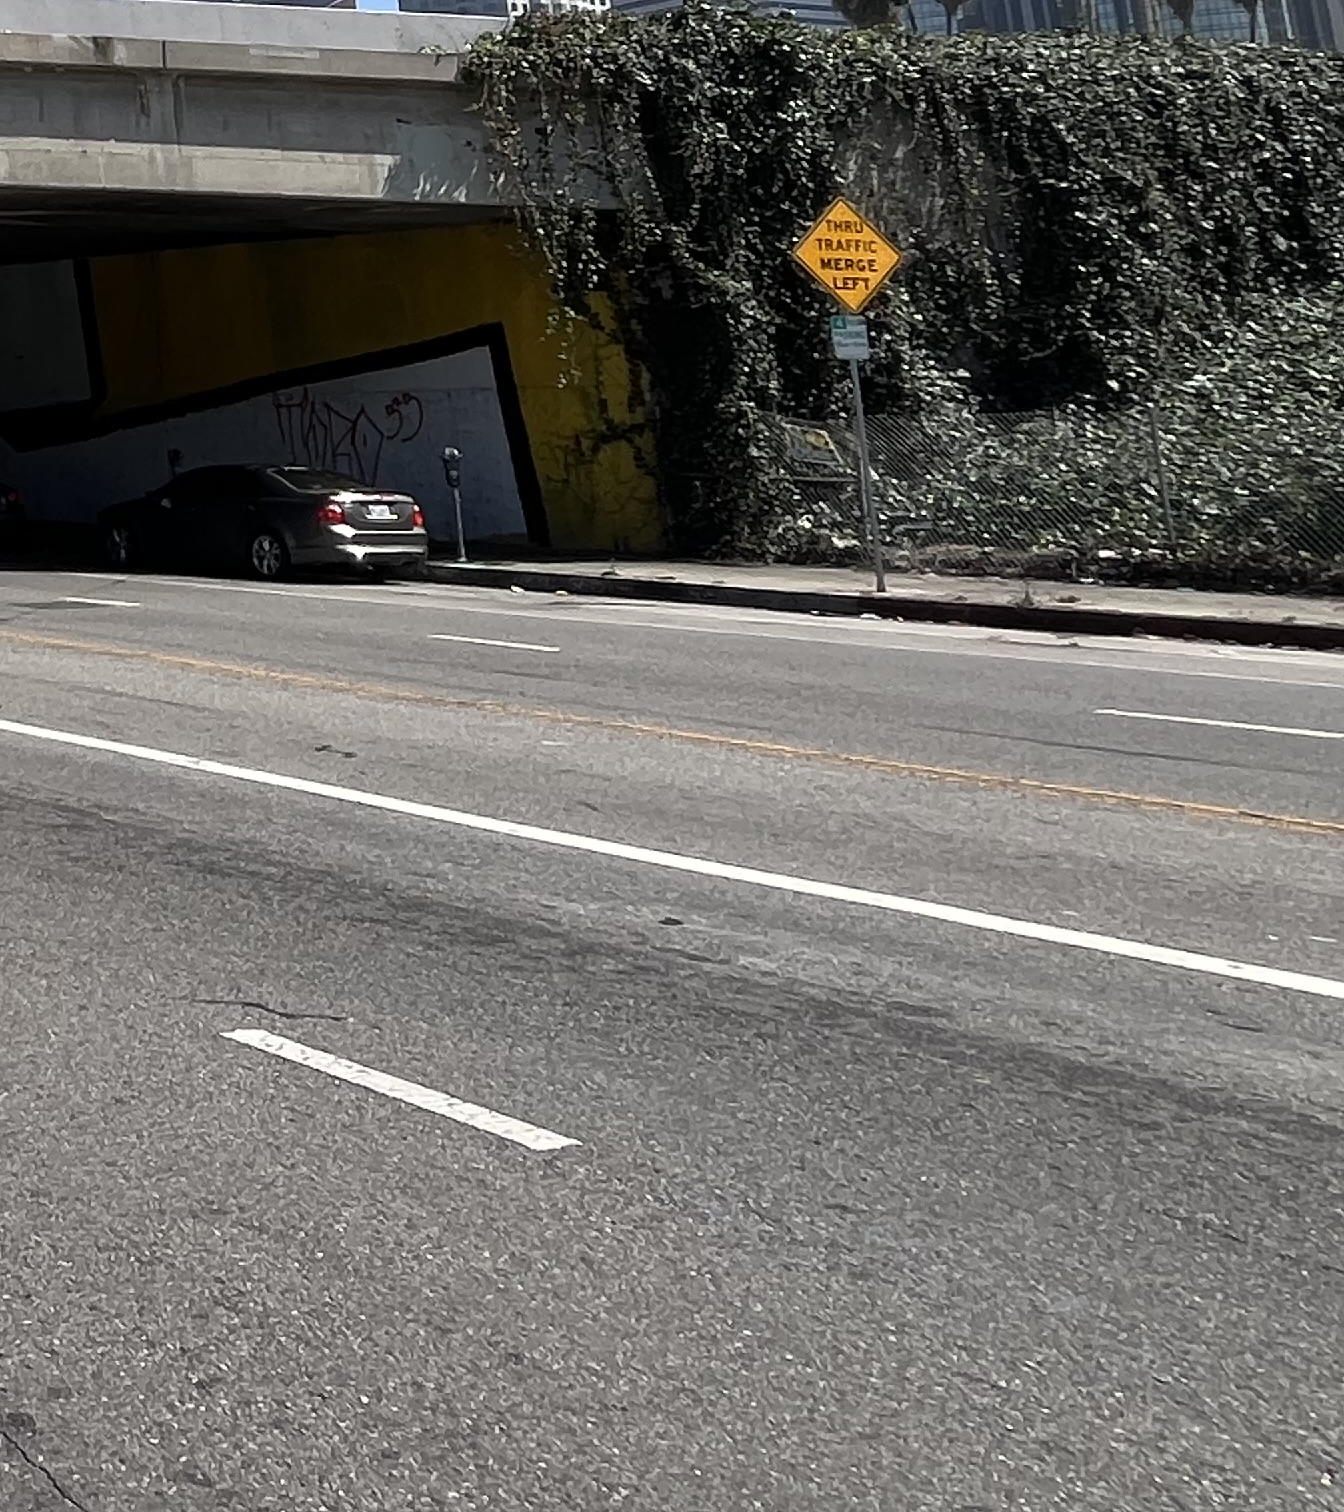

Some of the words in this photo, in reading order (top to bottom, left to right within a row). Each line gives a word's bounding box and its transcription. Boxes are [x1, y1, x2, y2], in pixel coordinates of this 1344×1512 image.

[825, 219, 864, 234] THRU
[815, 238, 879, 254] TRAFFIC
[820, 257, 879, 273] MERGE
[833, 276, 871, 291] LEFT
